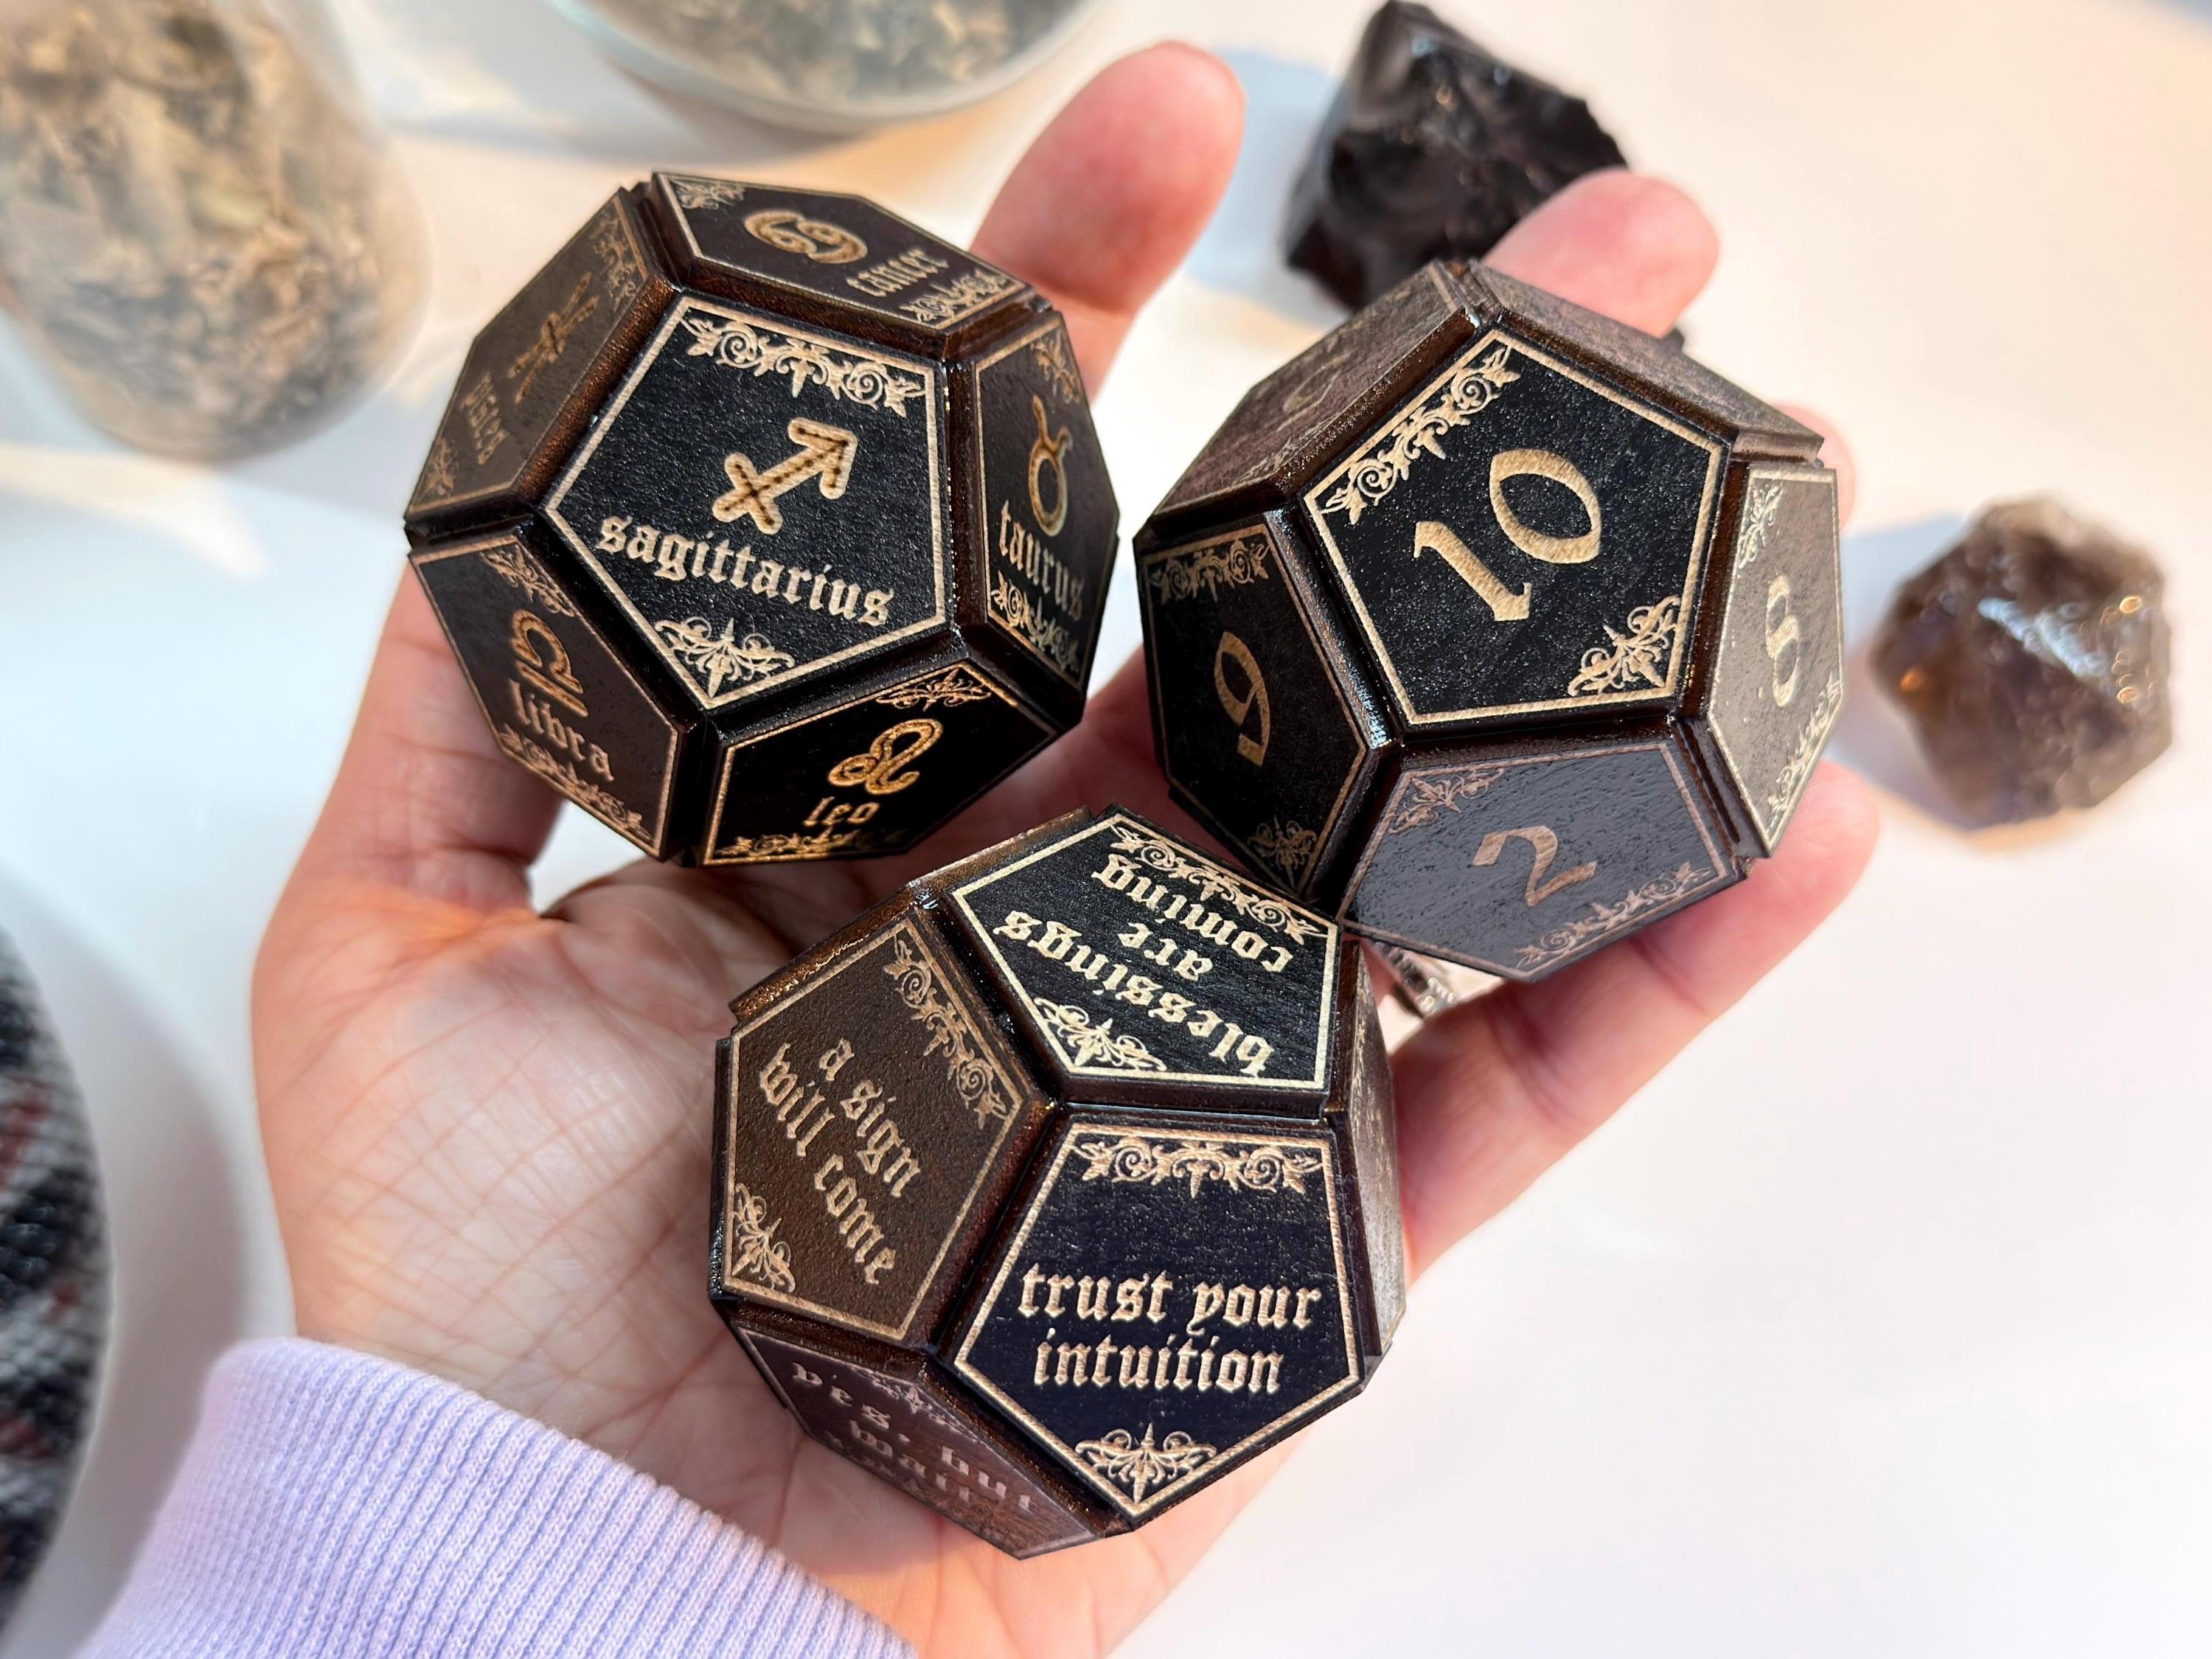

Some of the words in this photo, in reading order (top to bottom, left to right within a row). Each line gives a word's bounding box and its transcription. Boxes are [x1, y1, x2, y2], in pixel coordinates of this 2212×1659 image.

[846, 248, 949, 296] cancer
[596, 515, 894, 626] sagittarius
[999, 500, 1085, 621] taurus
[1413, 448, 1601, 622] 10
[509, 678, 618, 782] libra
[802, 796, 880, 827] leo
[1092, 854, 1293, 973] coming
[1472, 824, 1599, 908] 2
[993, 911, 1274, 1078] blessings
[1119, 922, 1212, 981] are
[760, 1043, 835, 1156] will
[814, 1155, 895, 1284] come
[819, 1037, 855, 1081] a
[840, 1079, 920, 1197] sign
[1018, 1262, 1173, 1324] trust
[1186, 1281, 1321, 1336] your
[1034, 1328, 1284, 1394] intuition
